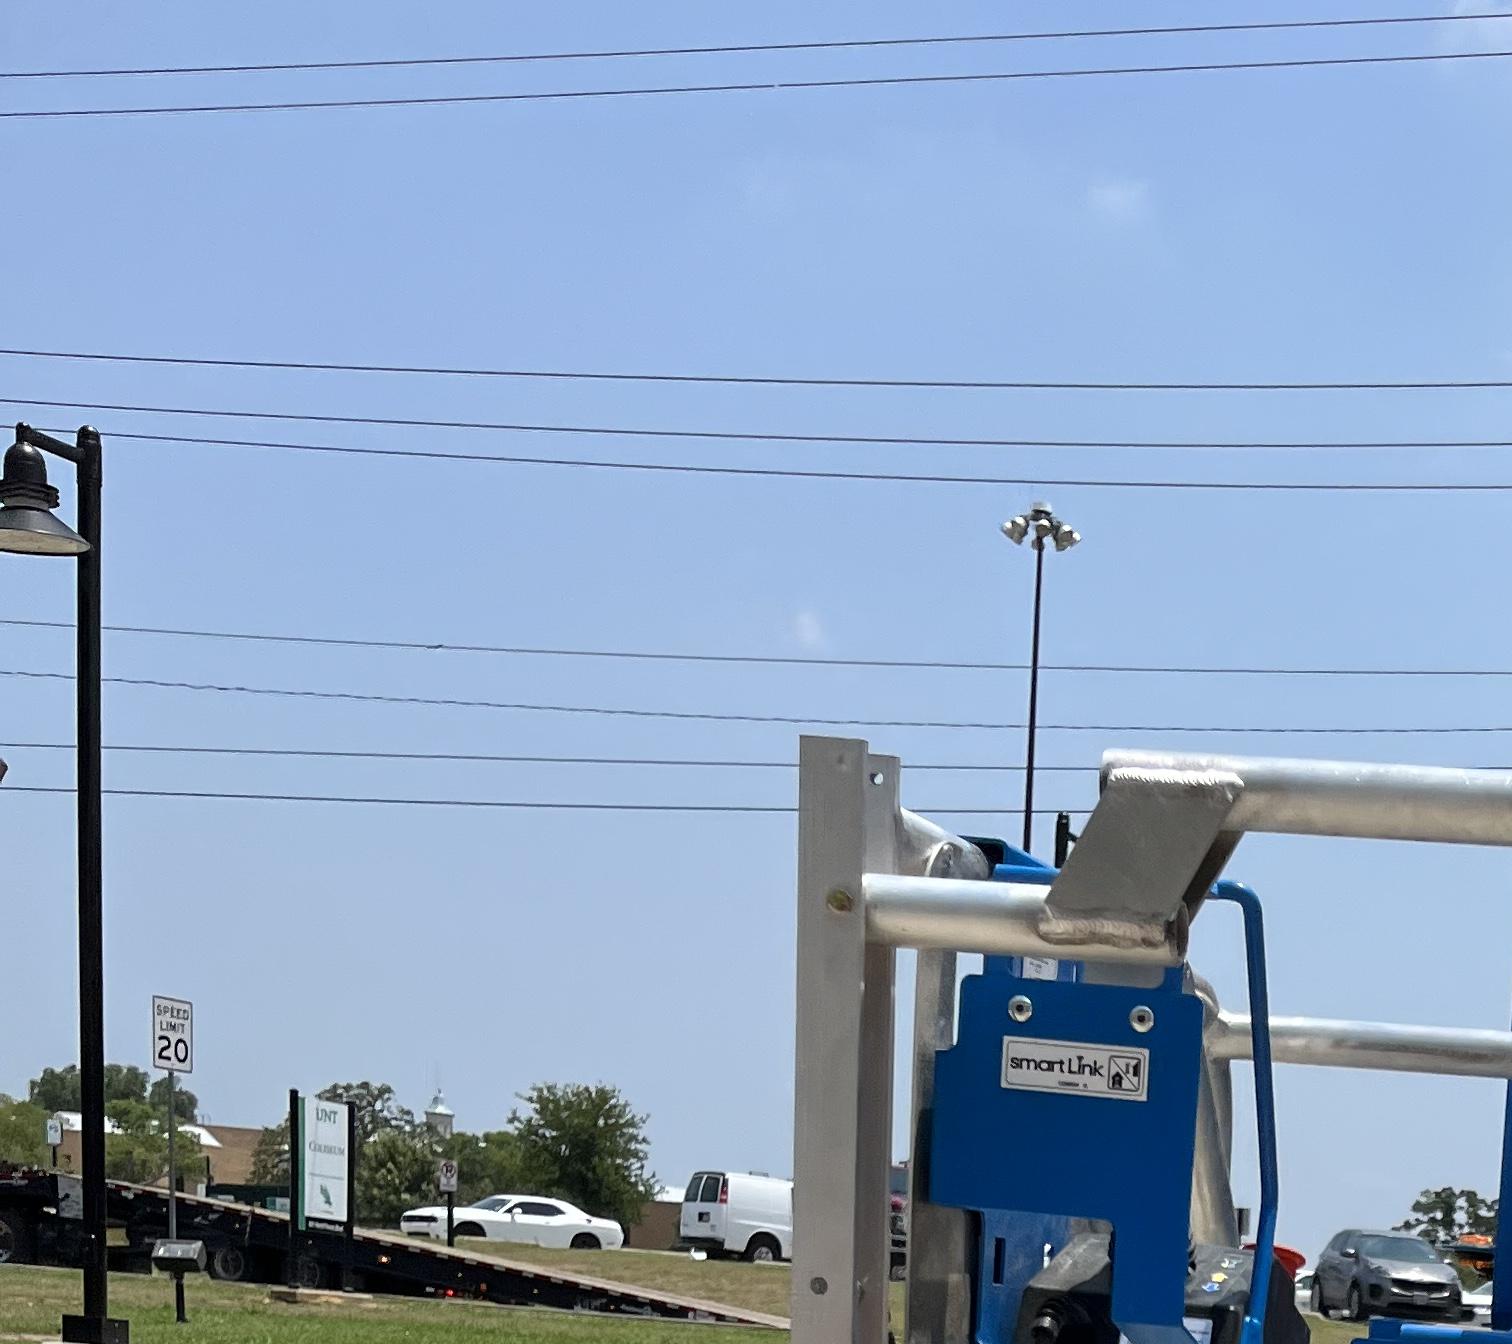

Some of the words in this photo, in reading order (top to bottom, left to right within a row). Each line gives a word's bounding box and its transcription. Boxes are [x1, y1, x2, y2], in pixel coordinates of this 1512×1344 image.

[157, 1004, 189, 1021] SPEED
[160, 1020, 186, 1034] LIMIT
[158, 1035, 189, 1064] 20
[315, 1106, 338, 1124] UNT
